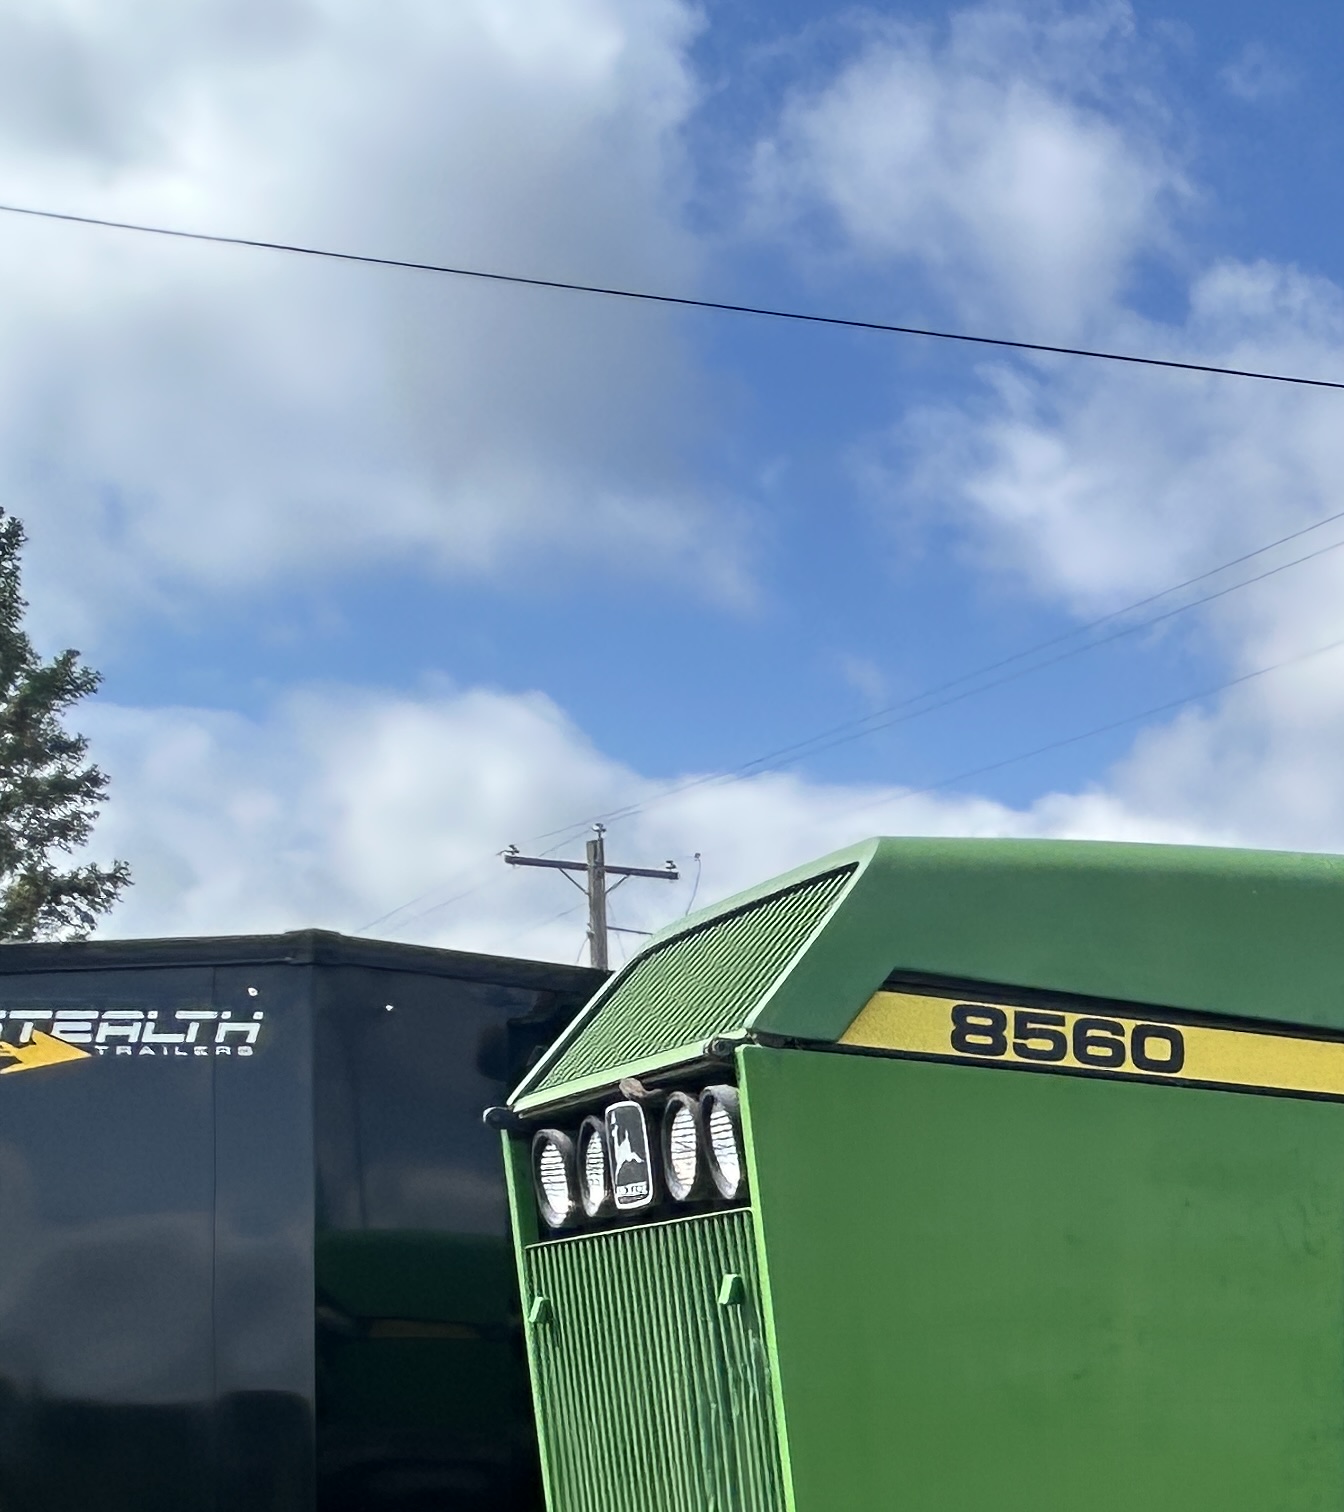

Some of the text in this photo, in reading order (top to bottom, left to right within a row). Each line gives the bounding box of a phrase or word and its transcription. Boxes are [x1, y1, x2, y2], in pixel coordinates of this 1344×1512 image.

[0, 1010, 264, 1043] TEALTH
[951, 1004, 1185, 1074] 8560
[94, 1045, 254, 1056] TRAILERS
